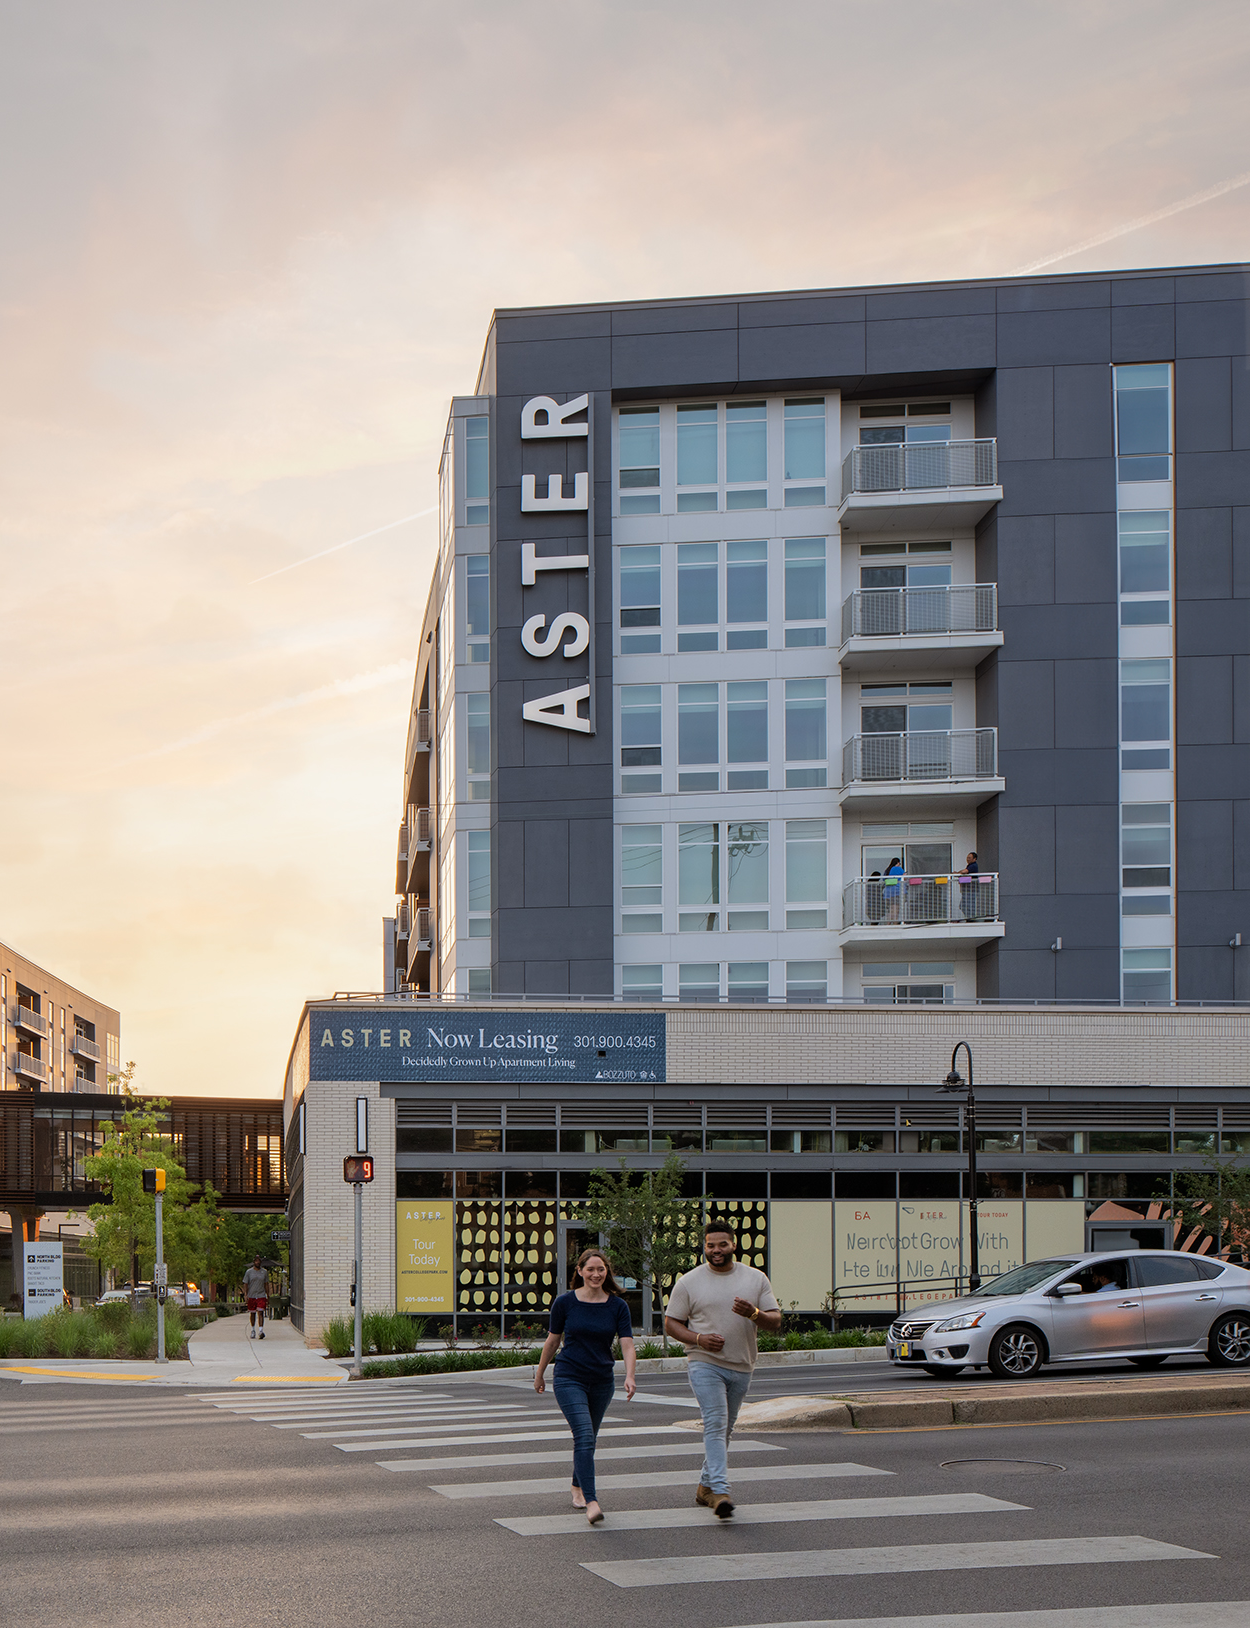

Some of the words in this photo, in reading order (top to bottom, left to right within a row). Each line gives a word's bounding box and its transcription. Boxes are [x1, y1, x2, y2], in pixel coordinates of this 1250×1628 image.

[521, 393, 590, 734] ASTER
[321, 1029, 411, 1047] ASTER
[427, 1028, 474, 1048] Now
[479, 1029, 558, 1053] Leasing
[573, 1035, 656, 1048] 301.900.4345
[402, 1056, 448, 1068] Decidedly
[450, 1057, 481, 1066] Grown
[483, 1057, 497, 1068] Up
[499, 1057, 546, 1068] Apartment
[548, 1057, 576, 1069] Living
[603, 1070, 637, 1079] BOZZUTO
[363, 1161, 372, 1179] 9
[406, 1211, 441, 1220] ASTER
[412, 1238, 436, 1250] Tour
[408, 1254, 441, 1267] Today
[940, 1260, 1001, 1277] Arond
